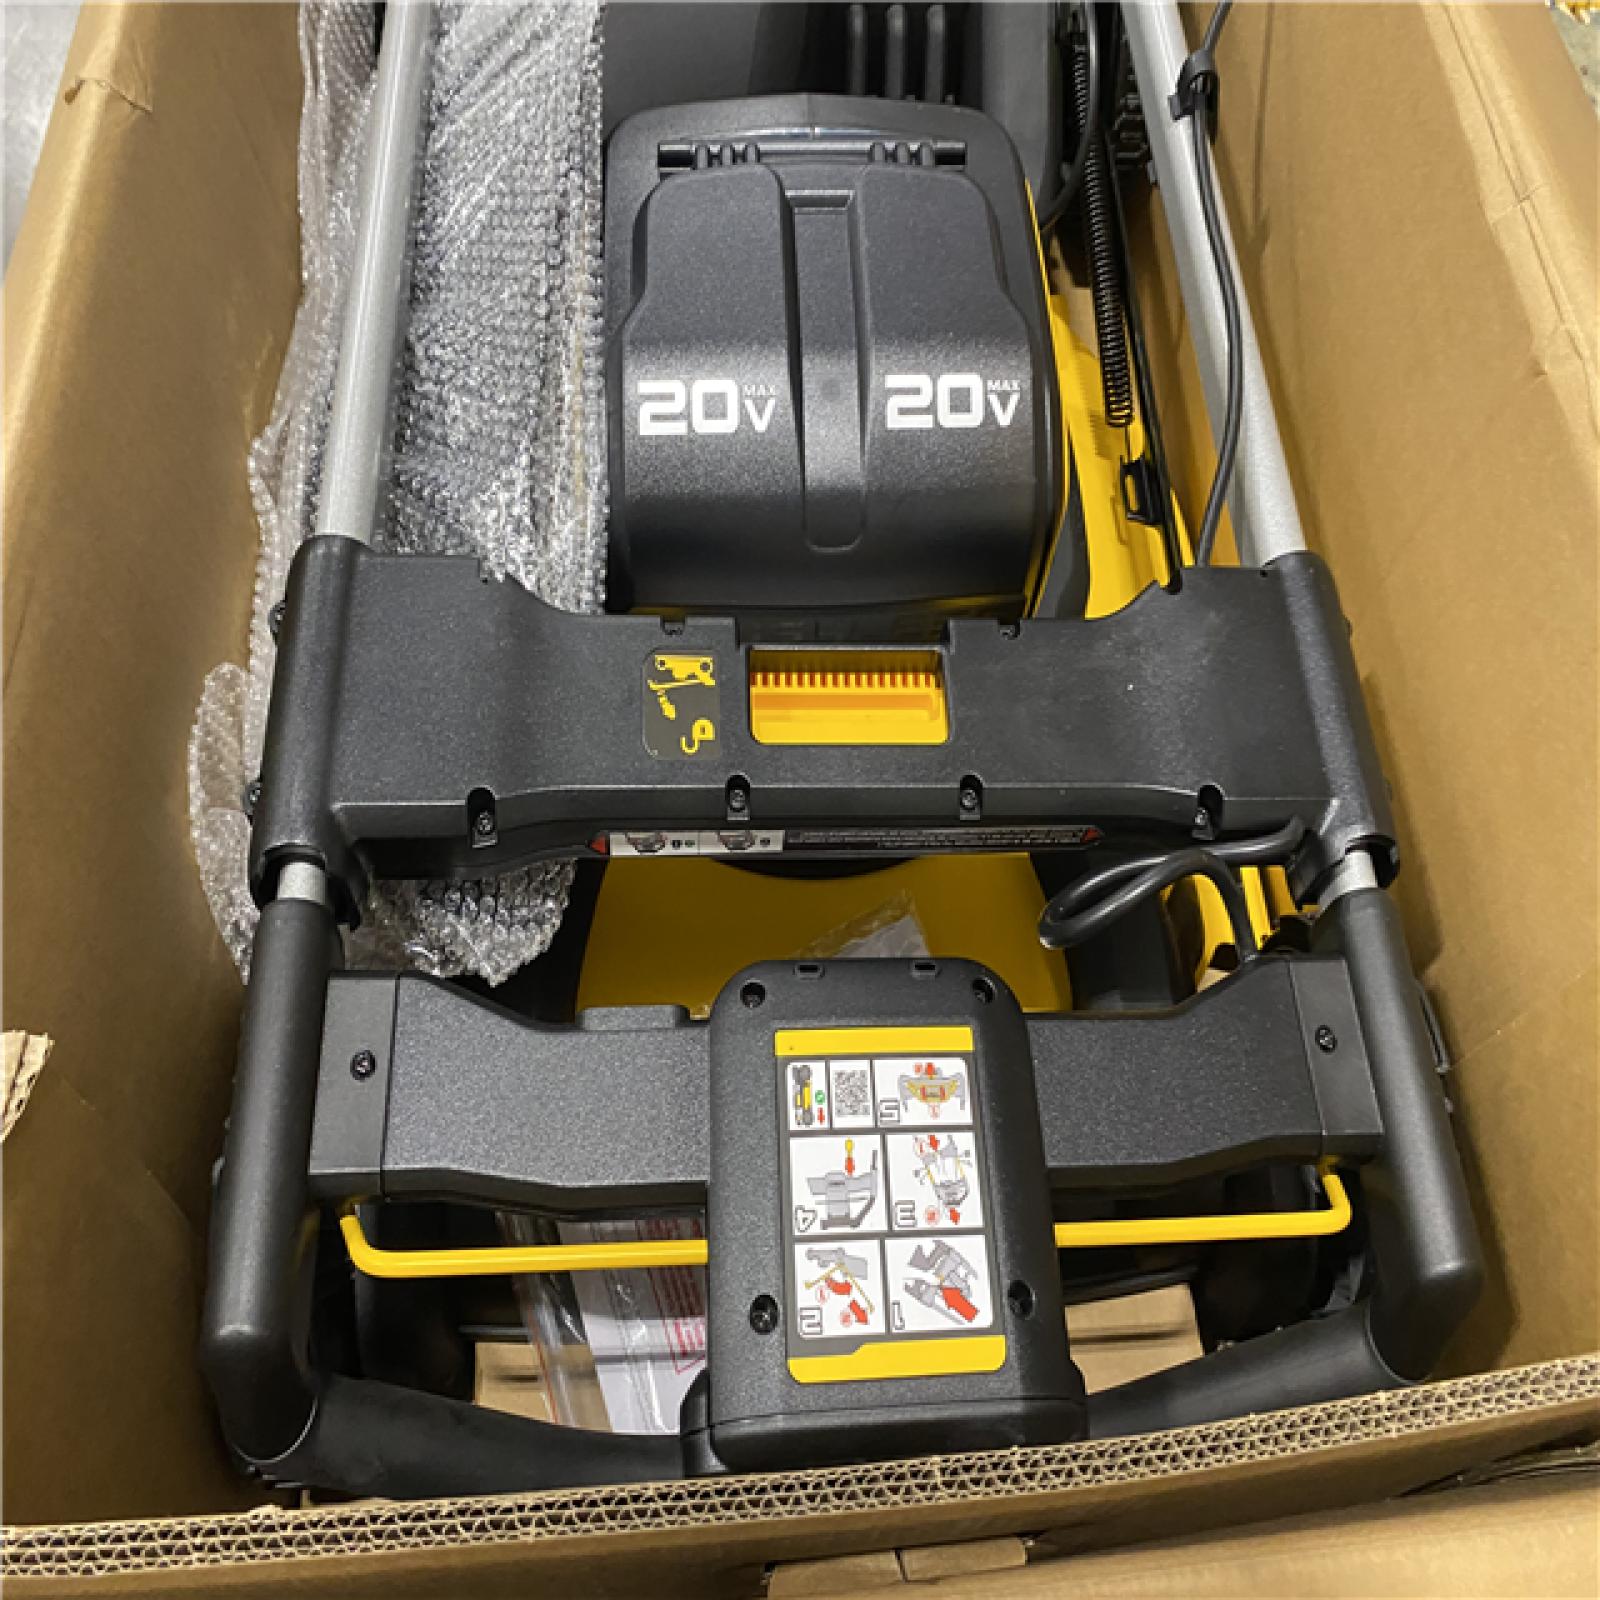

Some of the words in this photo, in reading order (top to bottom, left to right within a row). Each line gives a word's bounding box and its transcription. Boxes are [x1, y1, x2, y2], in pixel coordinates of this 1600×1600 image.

[879, 1098, 900, 1127] 5
[794, 1205, 818, 1233] 4
[894, 1199, 916, 1228] 3
[799, 1306, 823, 1336] 2
